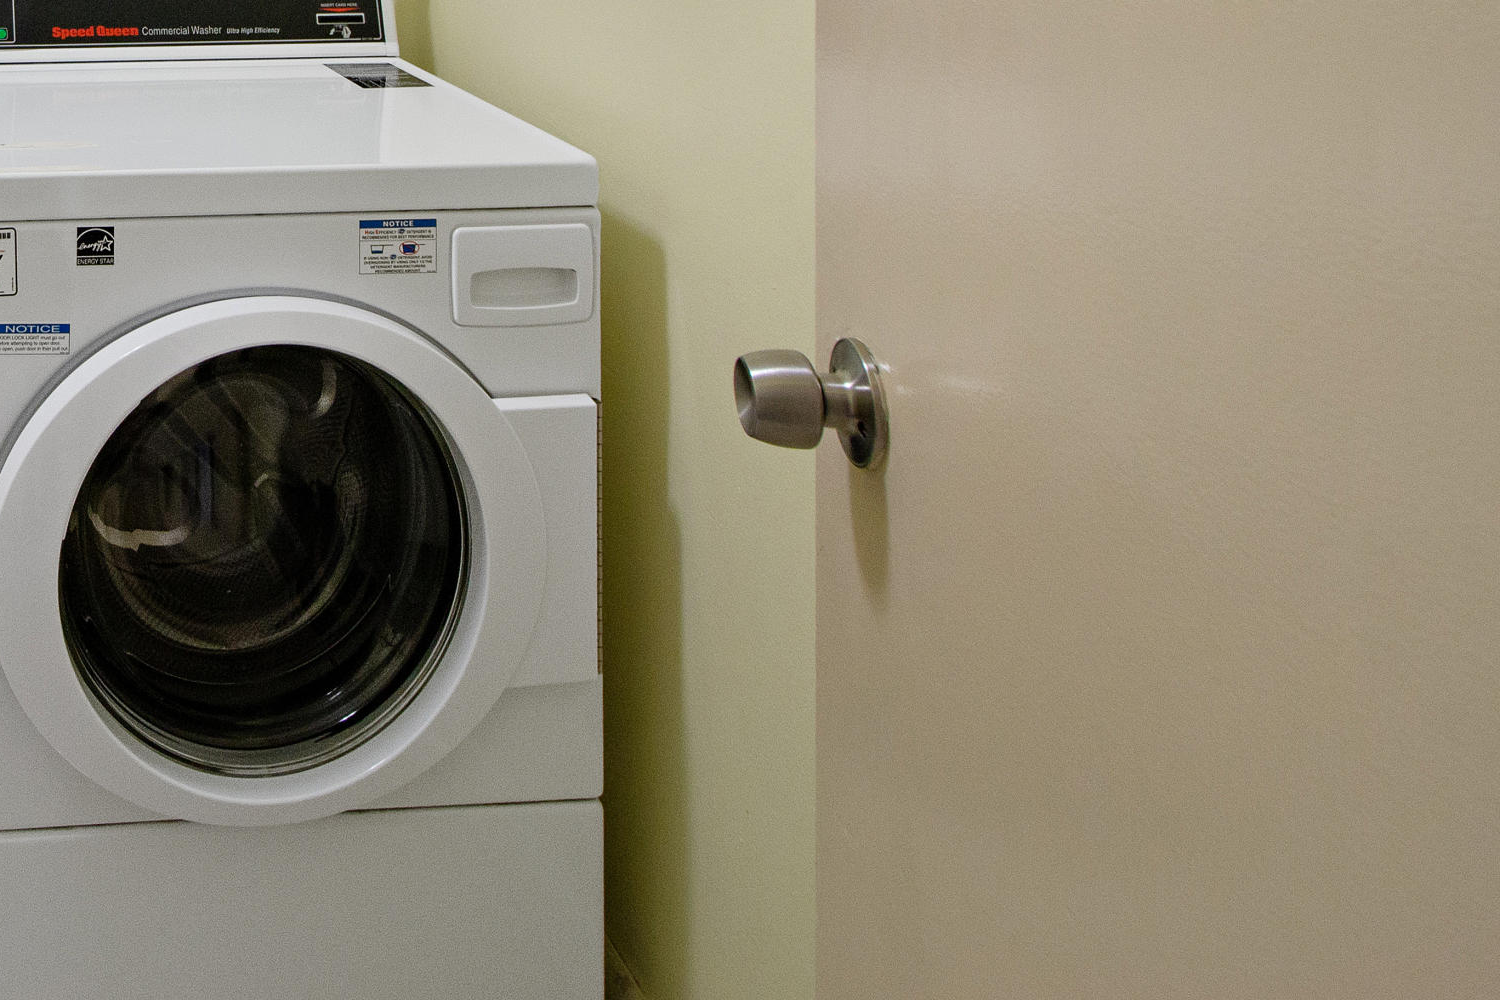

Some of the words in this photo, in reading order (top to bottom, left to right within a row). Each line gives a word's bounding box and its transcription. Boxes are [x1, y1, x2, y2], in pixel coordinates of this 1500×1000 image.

[52, 26, 94, 39] Speed
[96, 26, 138, 37] Queen
[141, 25, 189, 36] Commercial
[192, 25, 222, 35] Washer
[5, 325, 60, 333] NOTICE
